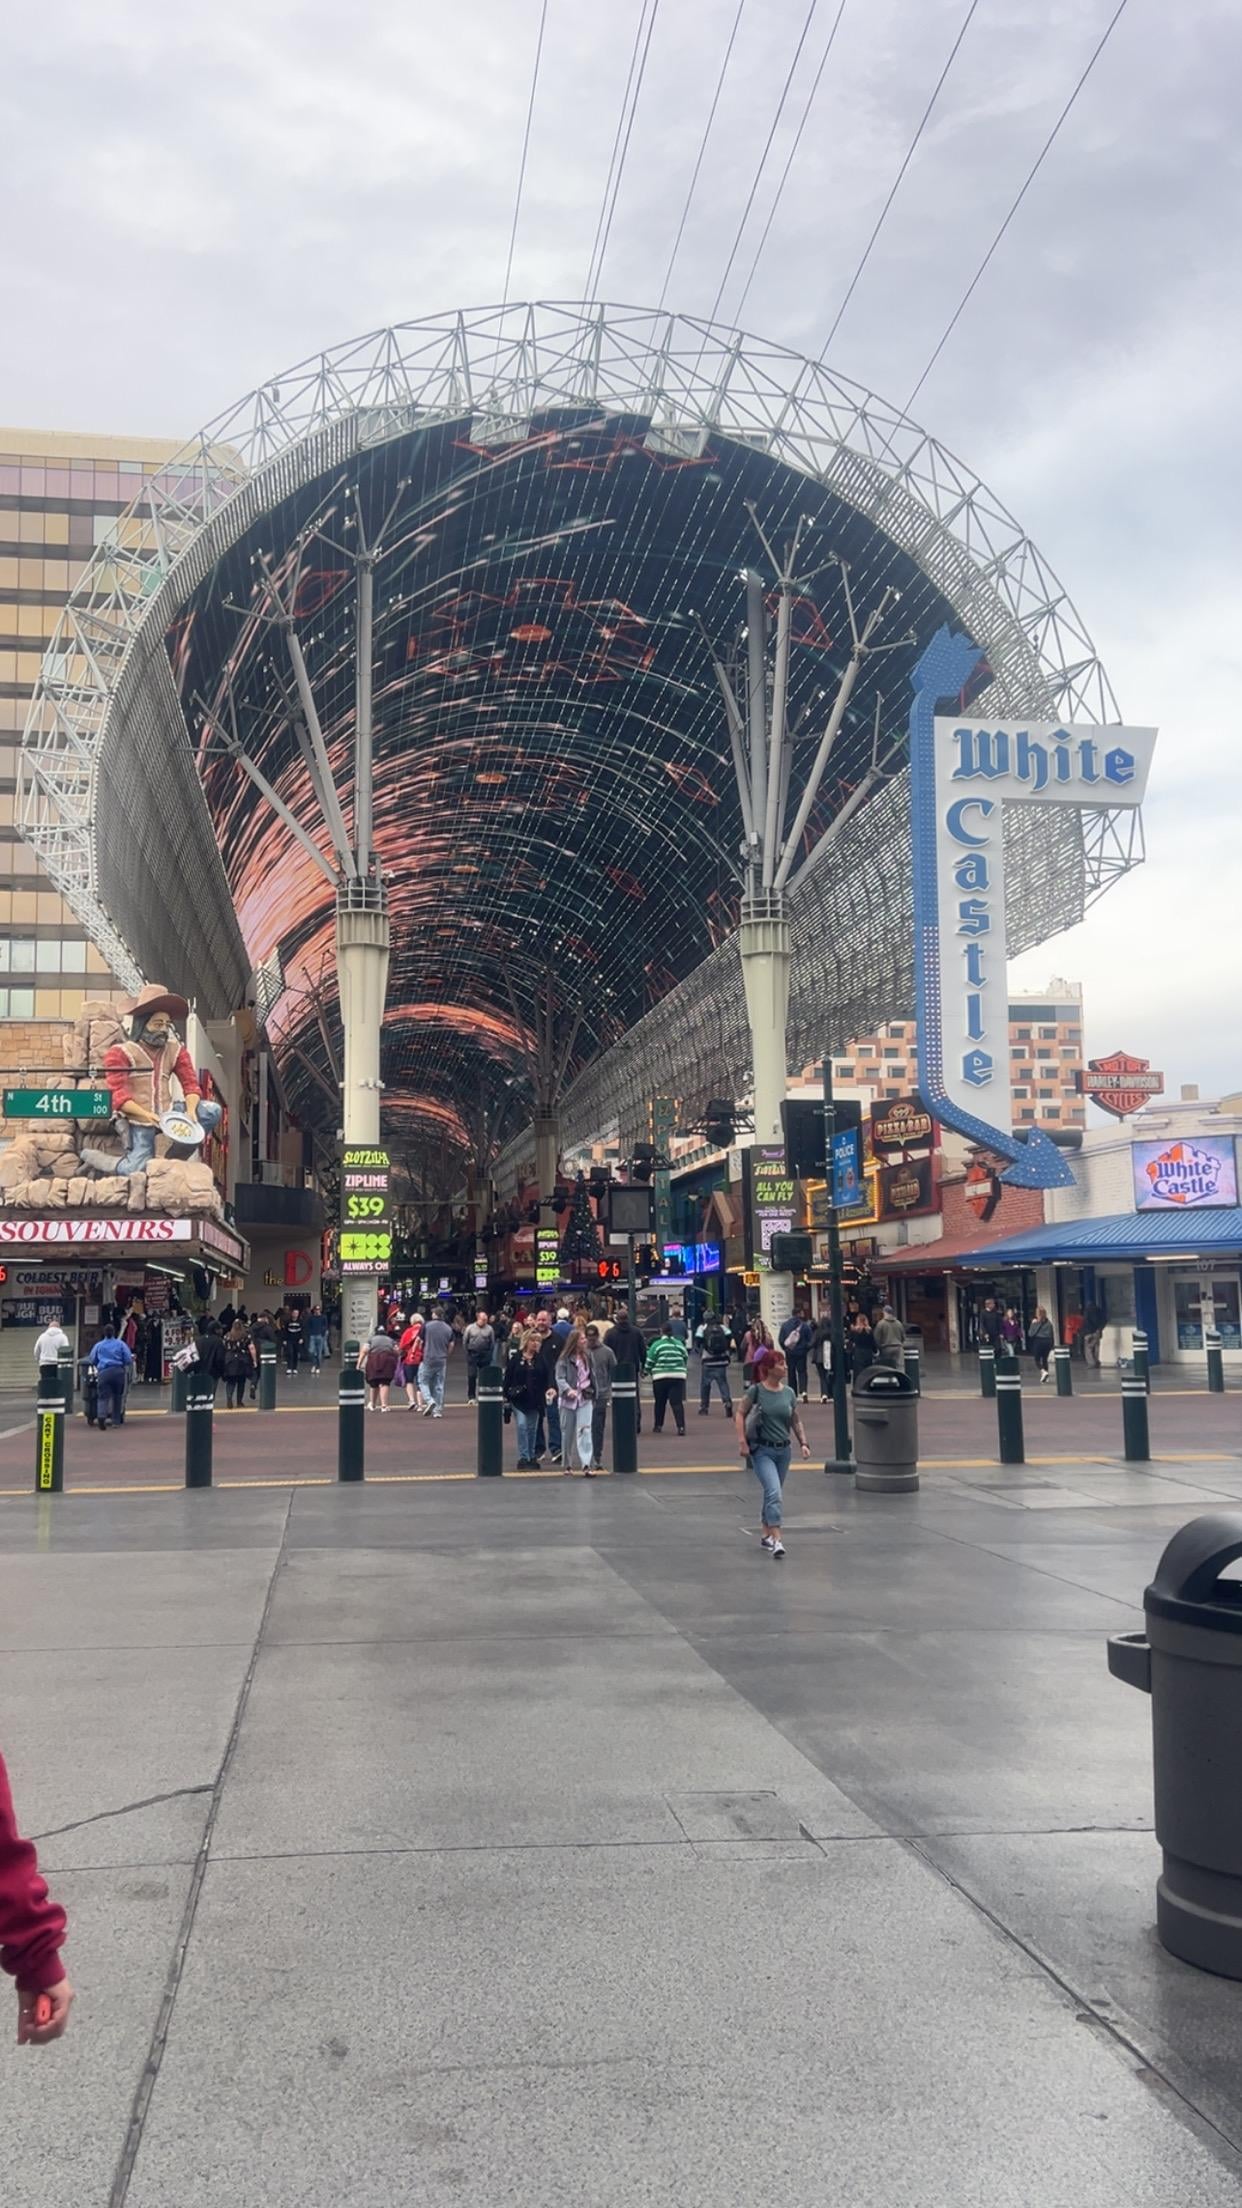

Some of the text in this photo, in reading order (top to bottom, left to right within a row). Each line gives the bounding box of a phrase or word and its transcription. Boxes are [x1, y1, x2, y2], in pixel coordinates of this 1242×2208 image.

[951, 727, 1137, 793] White
[945, 797, 995, 1089] Castle
[7, 1092, 102, 1113] N 4th St
[92, 1105, 108, 1114] 100
[834, 1143, 855, 1160] POLICE
[1156, 1159, 1213, 1181] White
[344, 1174, 389, 1188] ZIPLINE
[756, 1180, 794, 1192] ALL YOU
[1153, 1175, 1217, 1196] Castle
[756, 1191, 794, 1202] CAN FLY
[347, 1195, 385, 1219] $39
[0, 1220, 174, 1241] SOUVENIRS
[264, 1269, 284, 1286] the
[284, 1249, 313, 1287] D
[343, 1262, 389, 1271] ALWAYS ON
[613, 1262, 620, 1277] 6
[16, 1272, 67, 1284] COLDEST
[38, 1305, 63, 1315] BUD
